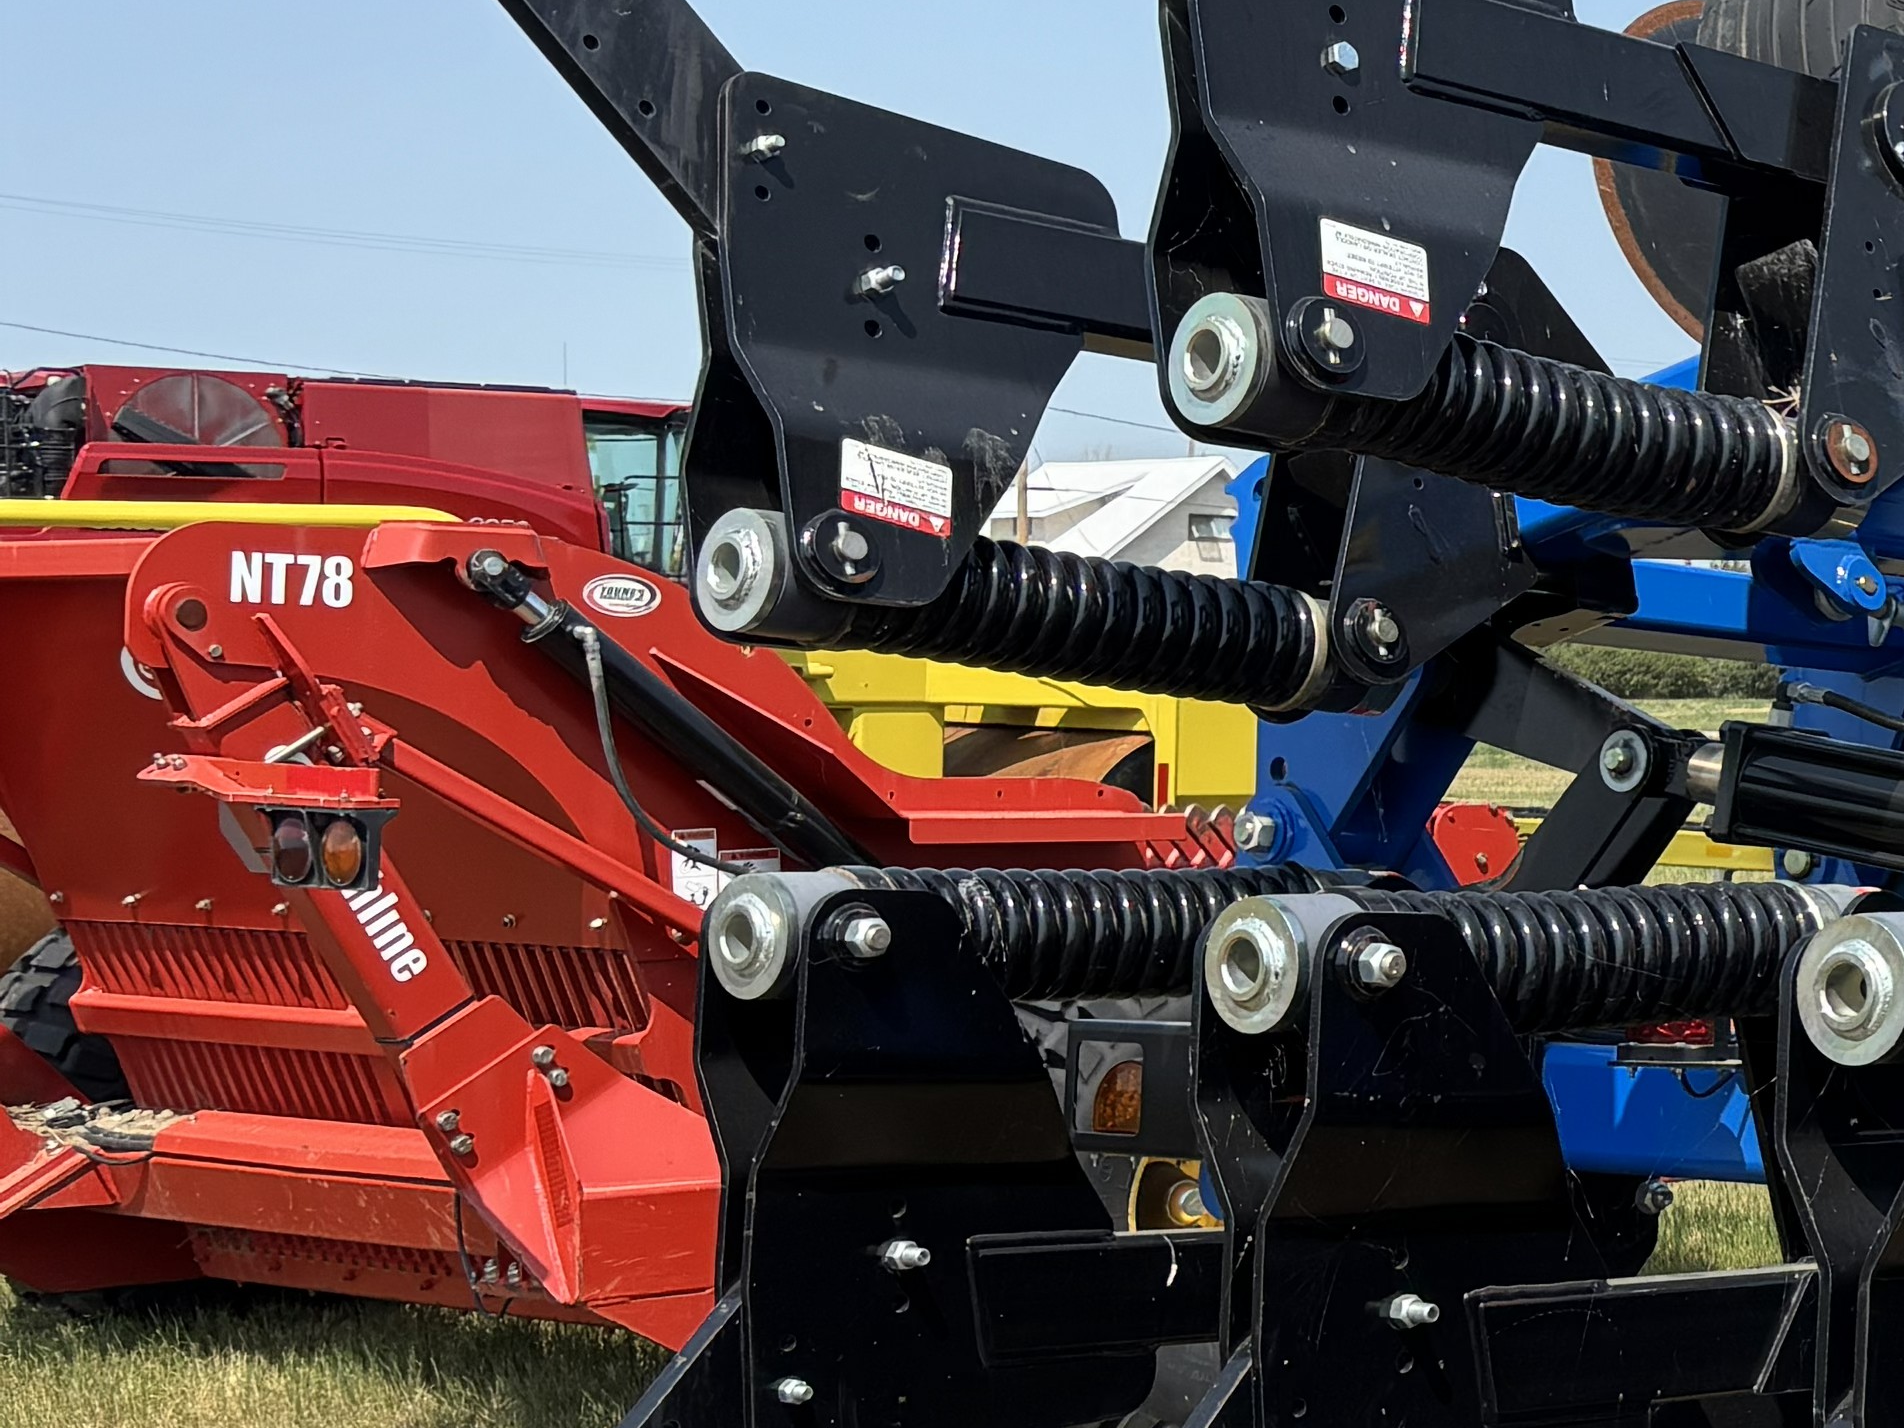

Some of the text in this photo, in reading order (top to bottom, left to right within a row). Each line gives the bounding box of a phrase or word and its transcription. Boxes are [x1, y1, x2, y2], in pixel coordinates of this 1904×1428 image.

[1335, 280, 1401, 314] DANGER
[853, 494, 920, 527] DANGER
[229, 550, 354, 609] NT78
